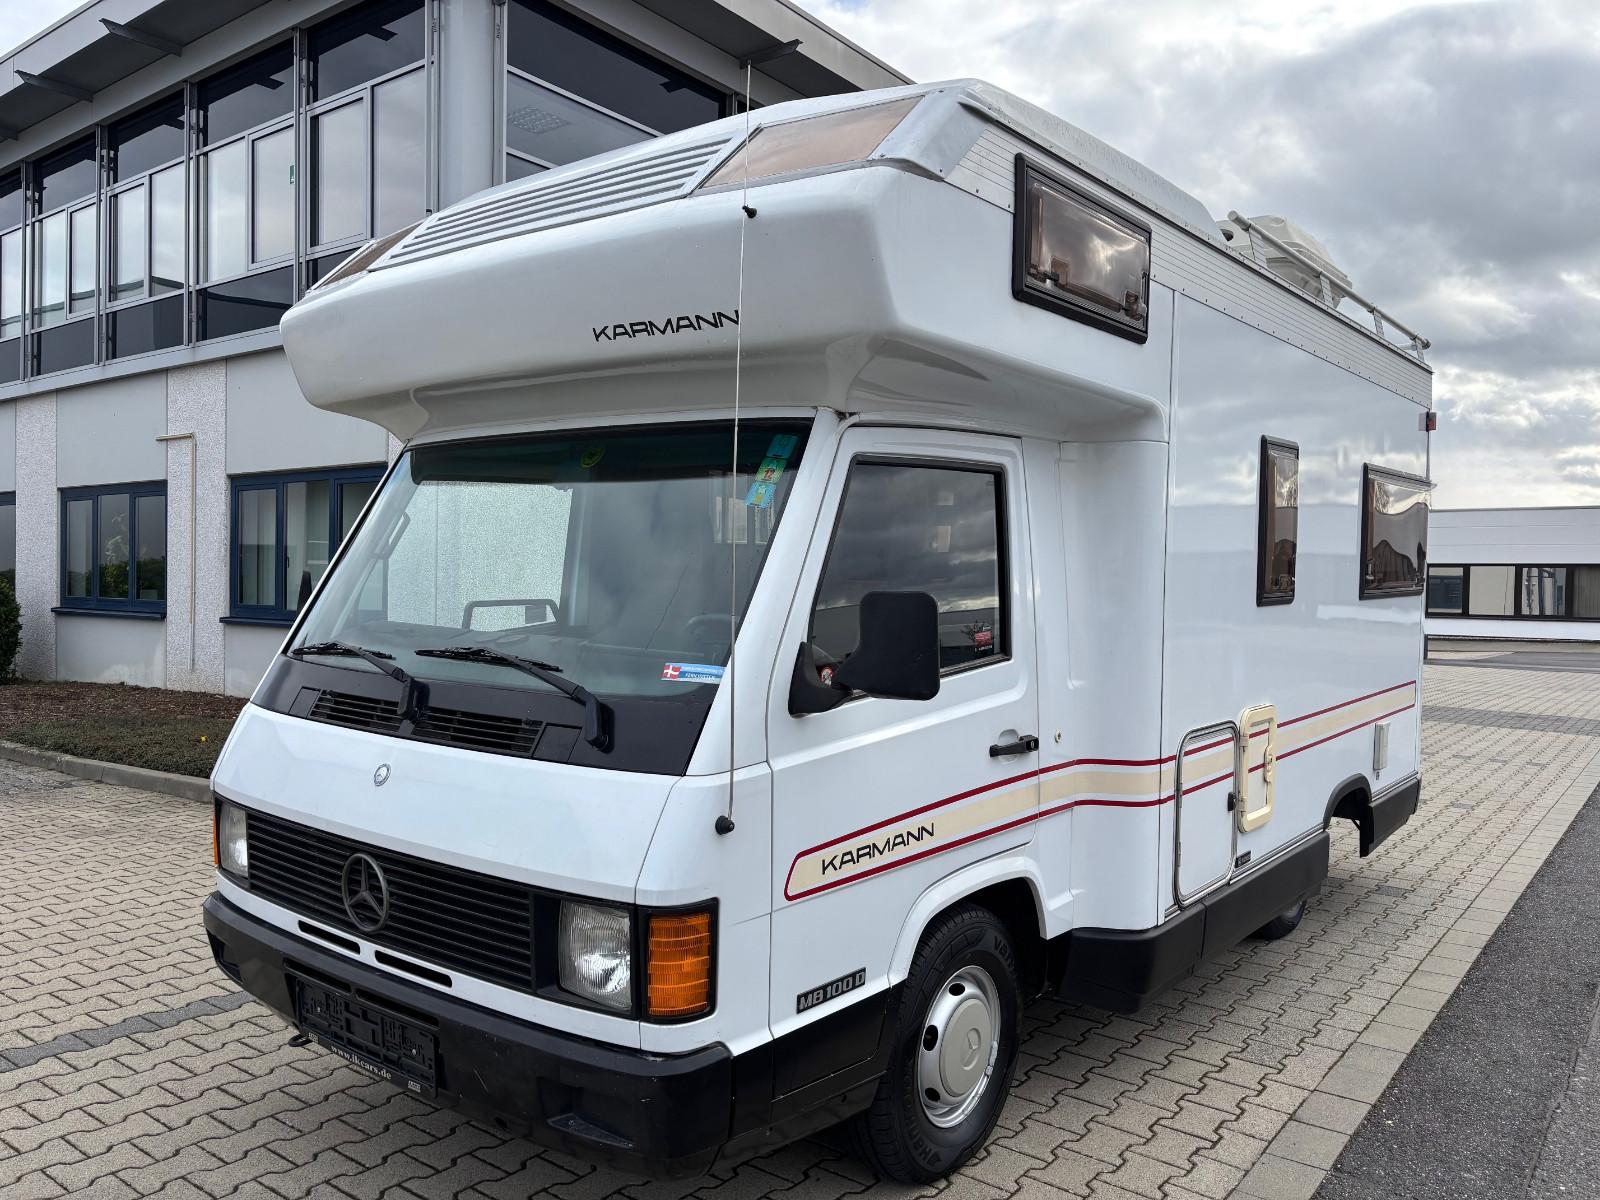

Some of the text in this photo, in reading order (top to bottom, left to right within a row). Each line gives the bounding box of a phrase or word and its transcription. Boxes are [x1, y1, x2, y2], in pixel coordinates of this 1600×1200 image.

[593, 309, 739, 342] KARMANN
[821, 822, 935, 875] KARMANN
[800, 971, 865, 1010] MB 100 D
